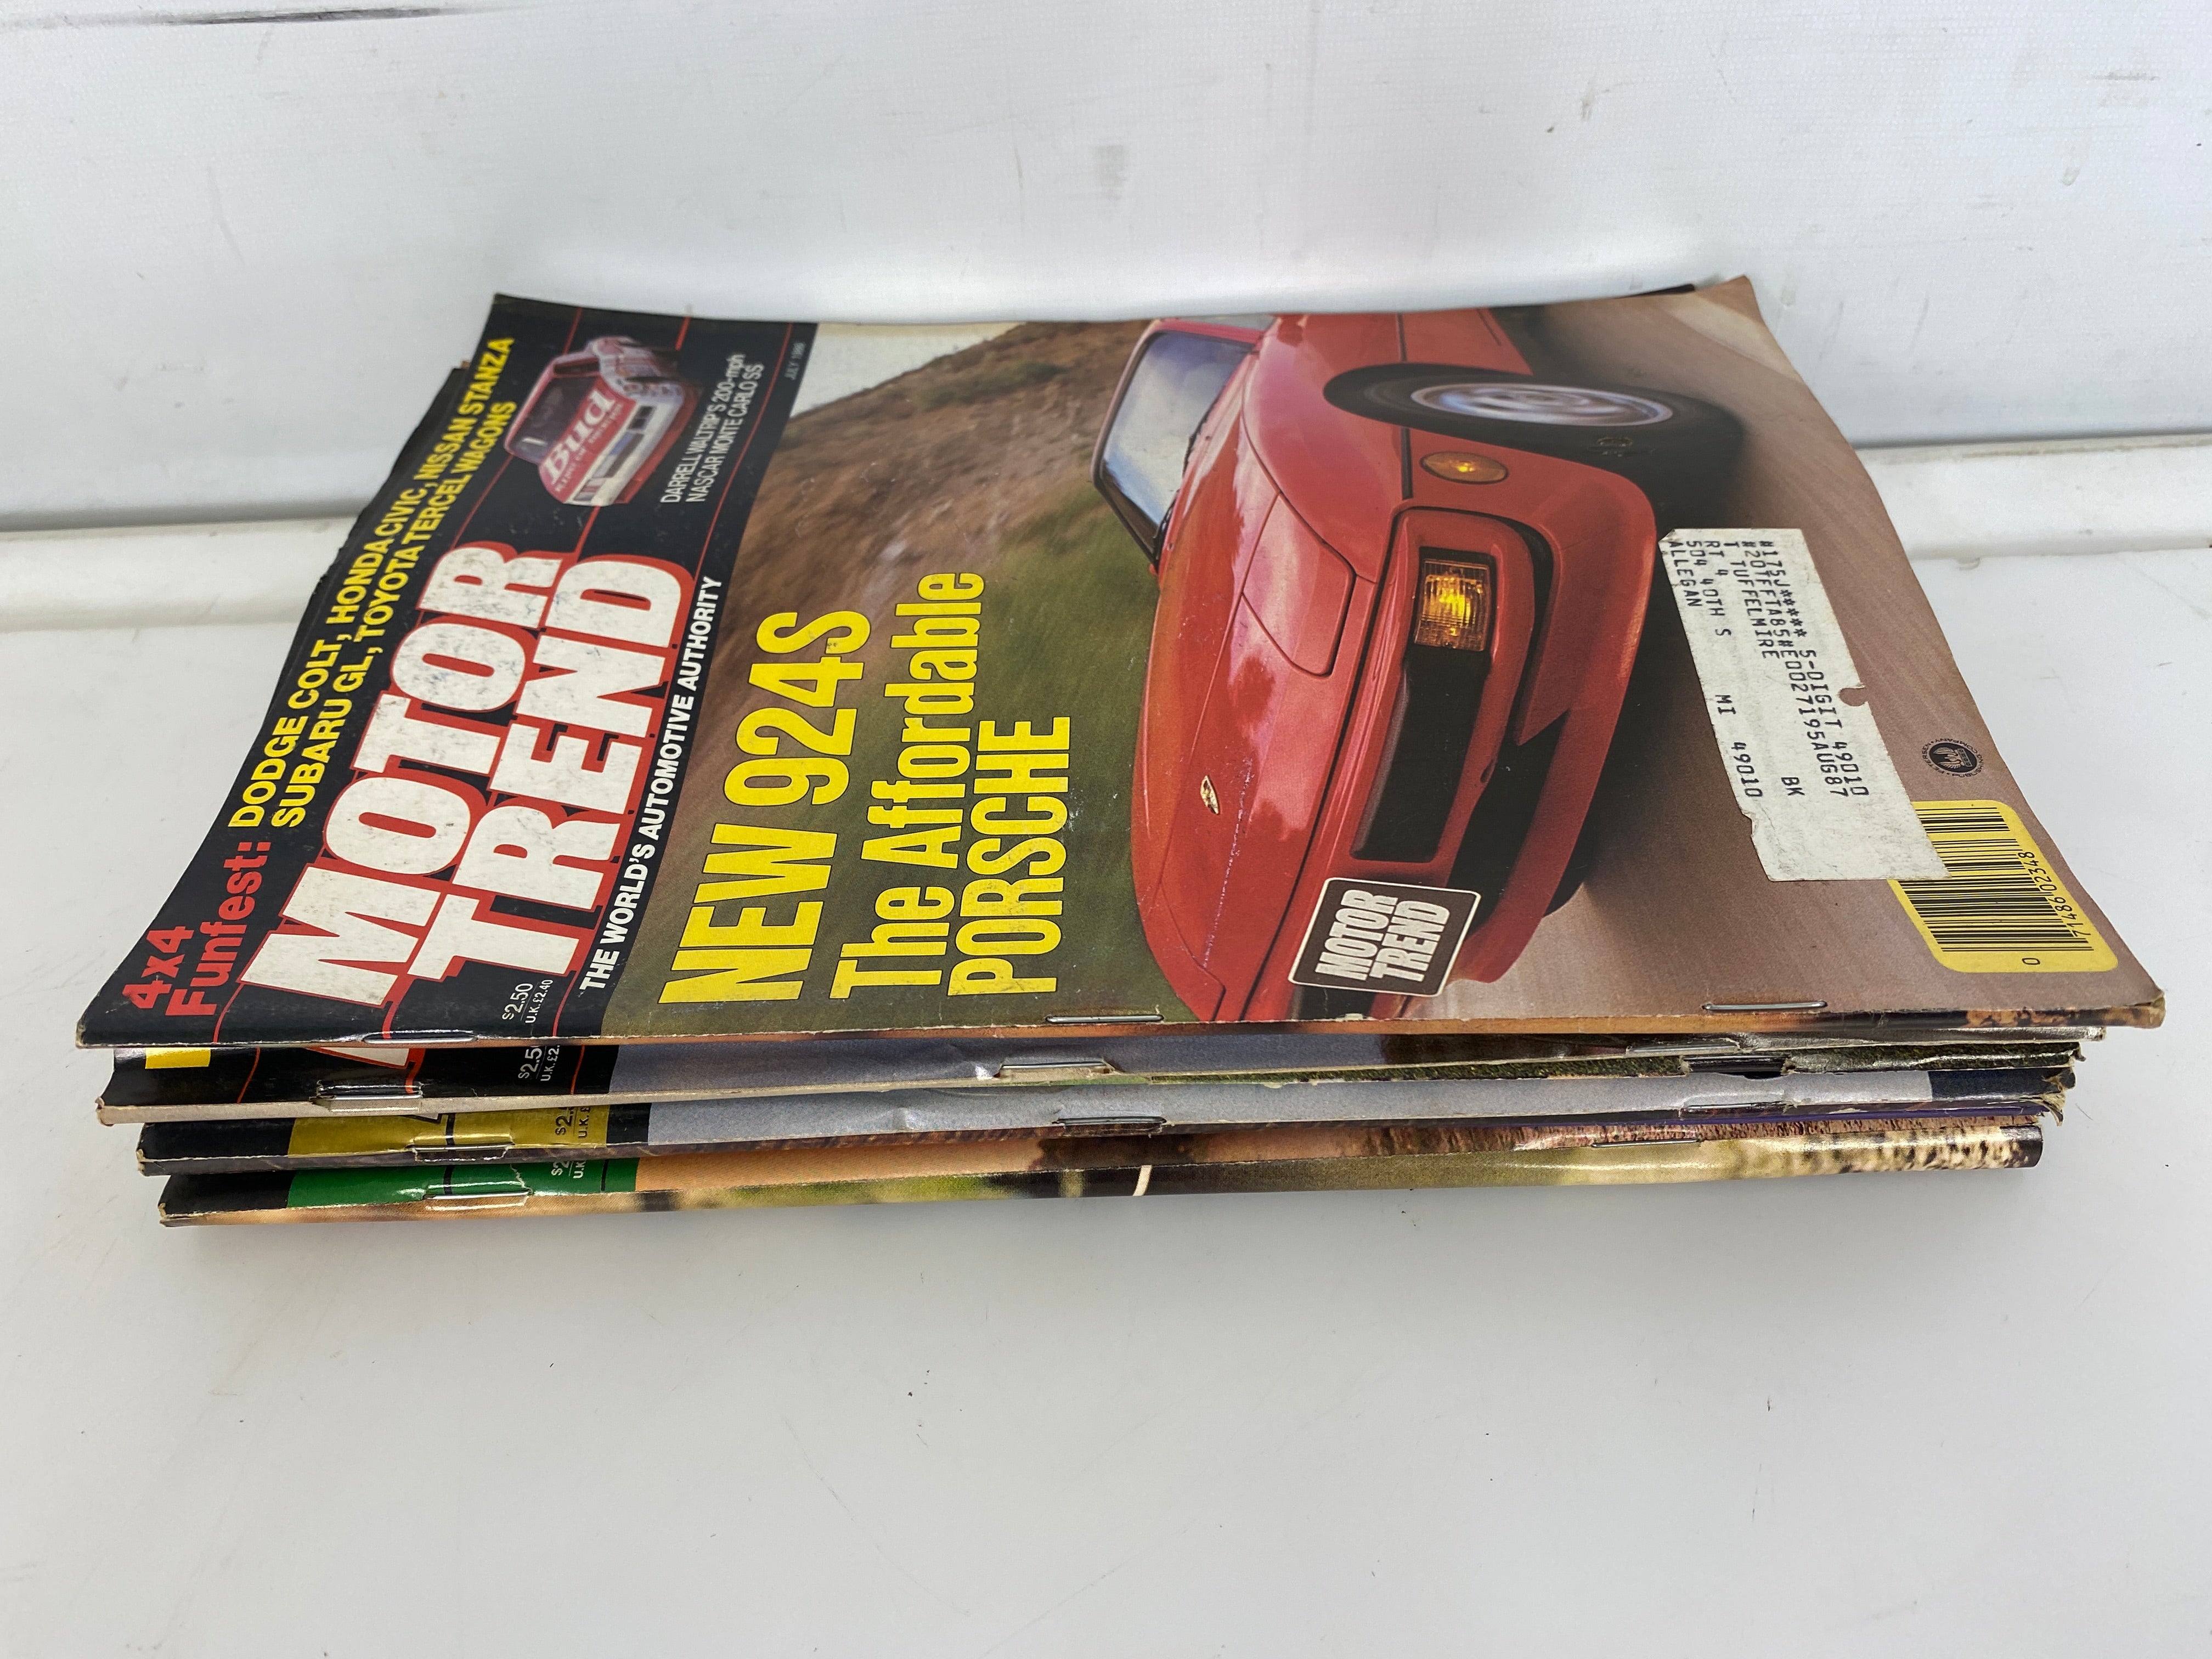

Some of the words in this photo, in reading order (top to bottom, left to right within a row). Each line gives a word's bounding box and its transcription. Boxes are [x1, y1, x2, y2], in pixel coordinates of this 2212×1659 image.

[727, 381, 758, 417] CARLO
[742, 363, 765, 380] SS
[450, 402, 517, 473] WAGONS
[544, 390, 616, 484] Bud
[660, 454, 702, 503] DARRELL
[711, 353, 746, 402] 200-mph
[709, 418, 743, 454] MONTE
[401, 474, 472, 544] TERCEL
[686, 455, 726, 502] NASCAR
[228, 716, 308, 827] DODGE
[288, 634, 352, 709] COLT,
[326, 539, 394, 624] HONDA
[413, 417, 477, 480] NISSAN
[458, 338, 515, 415] STANZA
[354, 545, 425, 642] TOYOTA
[1686, 541, 1707, 566] 504
[1700, 579, 1725, 616] 40TH
[1730, 560, 1780, 659] TUFFELMIRE
[333, 646, 383, 692] GL,
[725, 611, 871, 806] 924S
[1669, 541, 1702, 606] ALLEGAN
[1715, 695, 1736, 715] MI
[1731, 742, 1763, 797] 49010
[1705, 541, 1724, 557] RT
[1781, 777, 1805, 795] BK
[271, 698, 352, 827] SUBARU
[861, 573, 985, 869] Affordable
[1799, 650, 1842, 728] 5-DIGIT
[1832, 742, 1869, 795] 49010
[240, 546, 563, 1006] MOTOR
[408, 559, 682, 980] TREND
[579, 949, 619, 990] THE
[600, 844, 655, 944] WORLD'S
[639, 695, 695, 840] AUTOMOTIVE
[677, 576, 722, 691] AUTHORITY
[947, 716, 1071, 997] PORSCHE
[2018, 851, 2057, 891] 02348
[166, 842, 271, 1015] Funfest:
[659, 823, 837, 1004] NEW
[830, 886, 955, 999] The
[1315, 889, 1398, 981] MOTOR
[1369, 900, 1449, 982] TREND
[2048, 897, 2091, 937] 71486
[122, 926, 194, 1008] 4x4
[502, 983, 533, 1020] $2.50
[525, 980, 553, 1023] U.K.£2.40
[518, 1046, 542, 1079] $2.5
